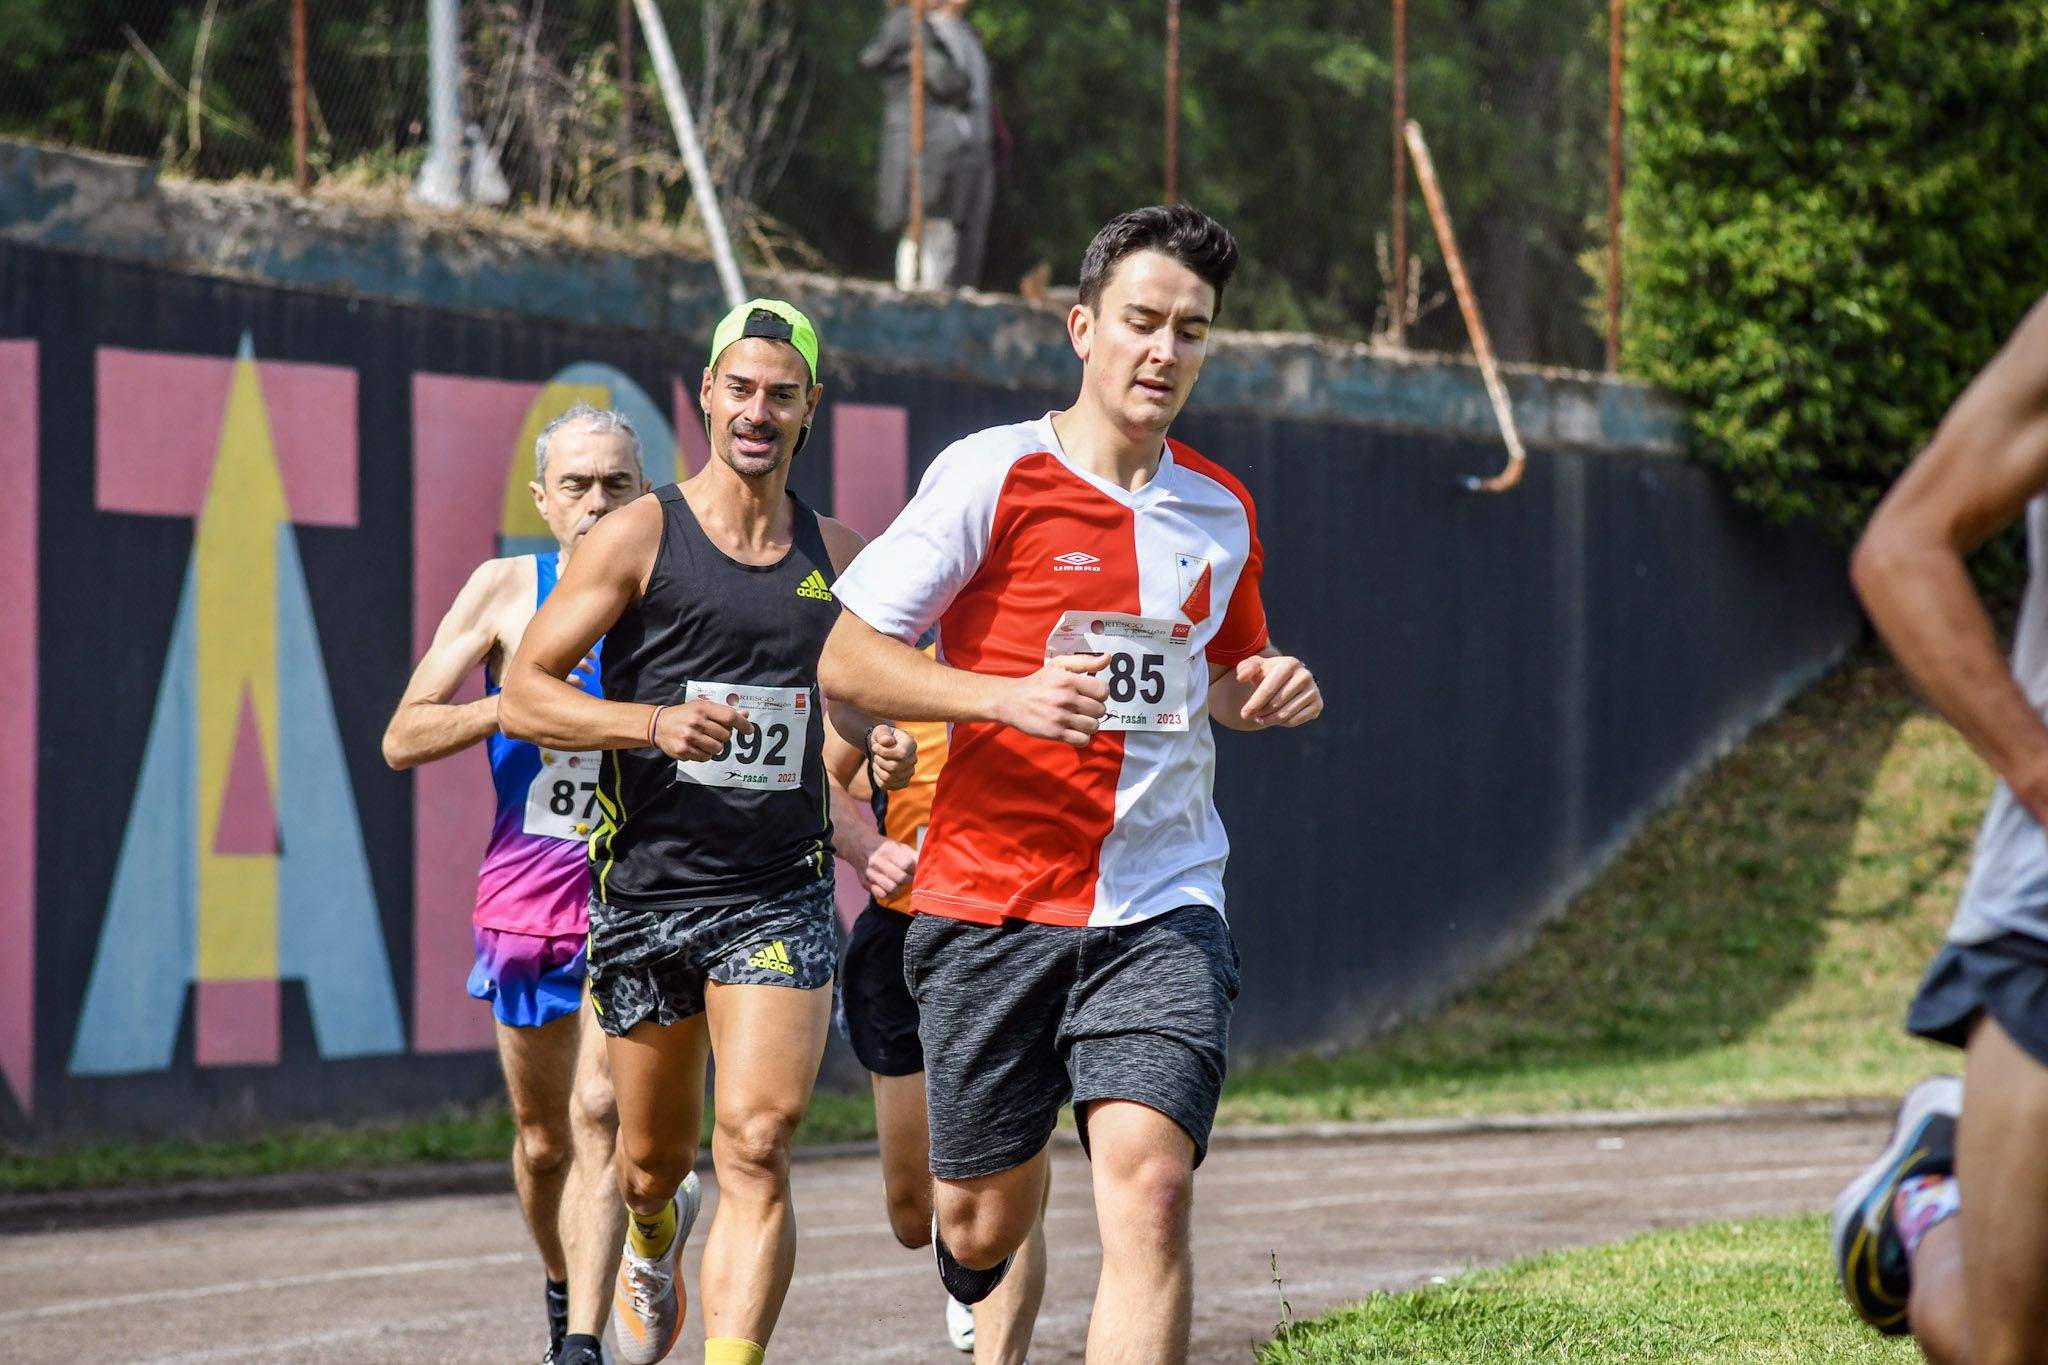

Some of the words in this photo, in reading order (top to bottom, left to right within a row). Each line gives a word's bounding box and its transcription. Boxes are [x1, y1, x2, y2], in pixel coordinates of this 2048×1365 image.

[796, 586, 833, 602] adidas
[1074, 652, 1166, 705] 85
[1156, 713, 1182, 725] 2023
[777, 773, 796, 783] 2023
[748, 956, 795, 976] adidas
